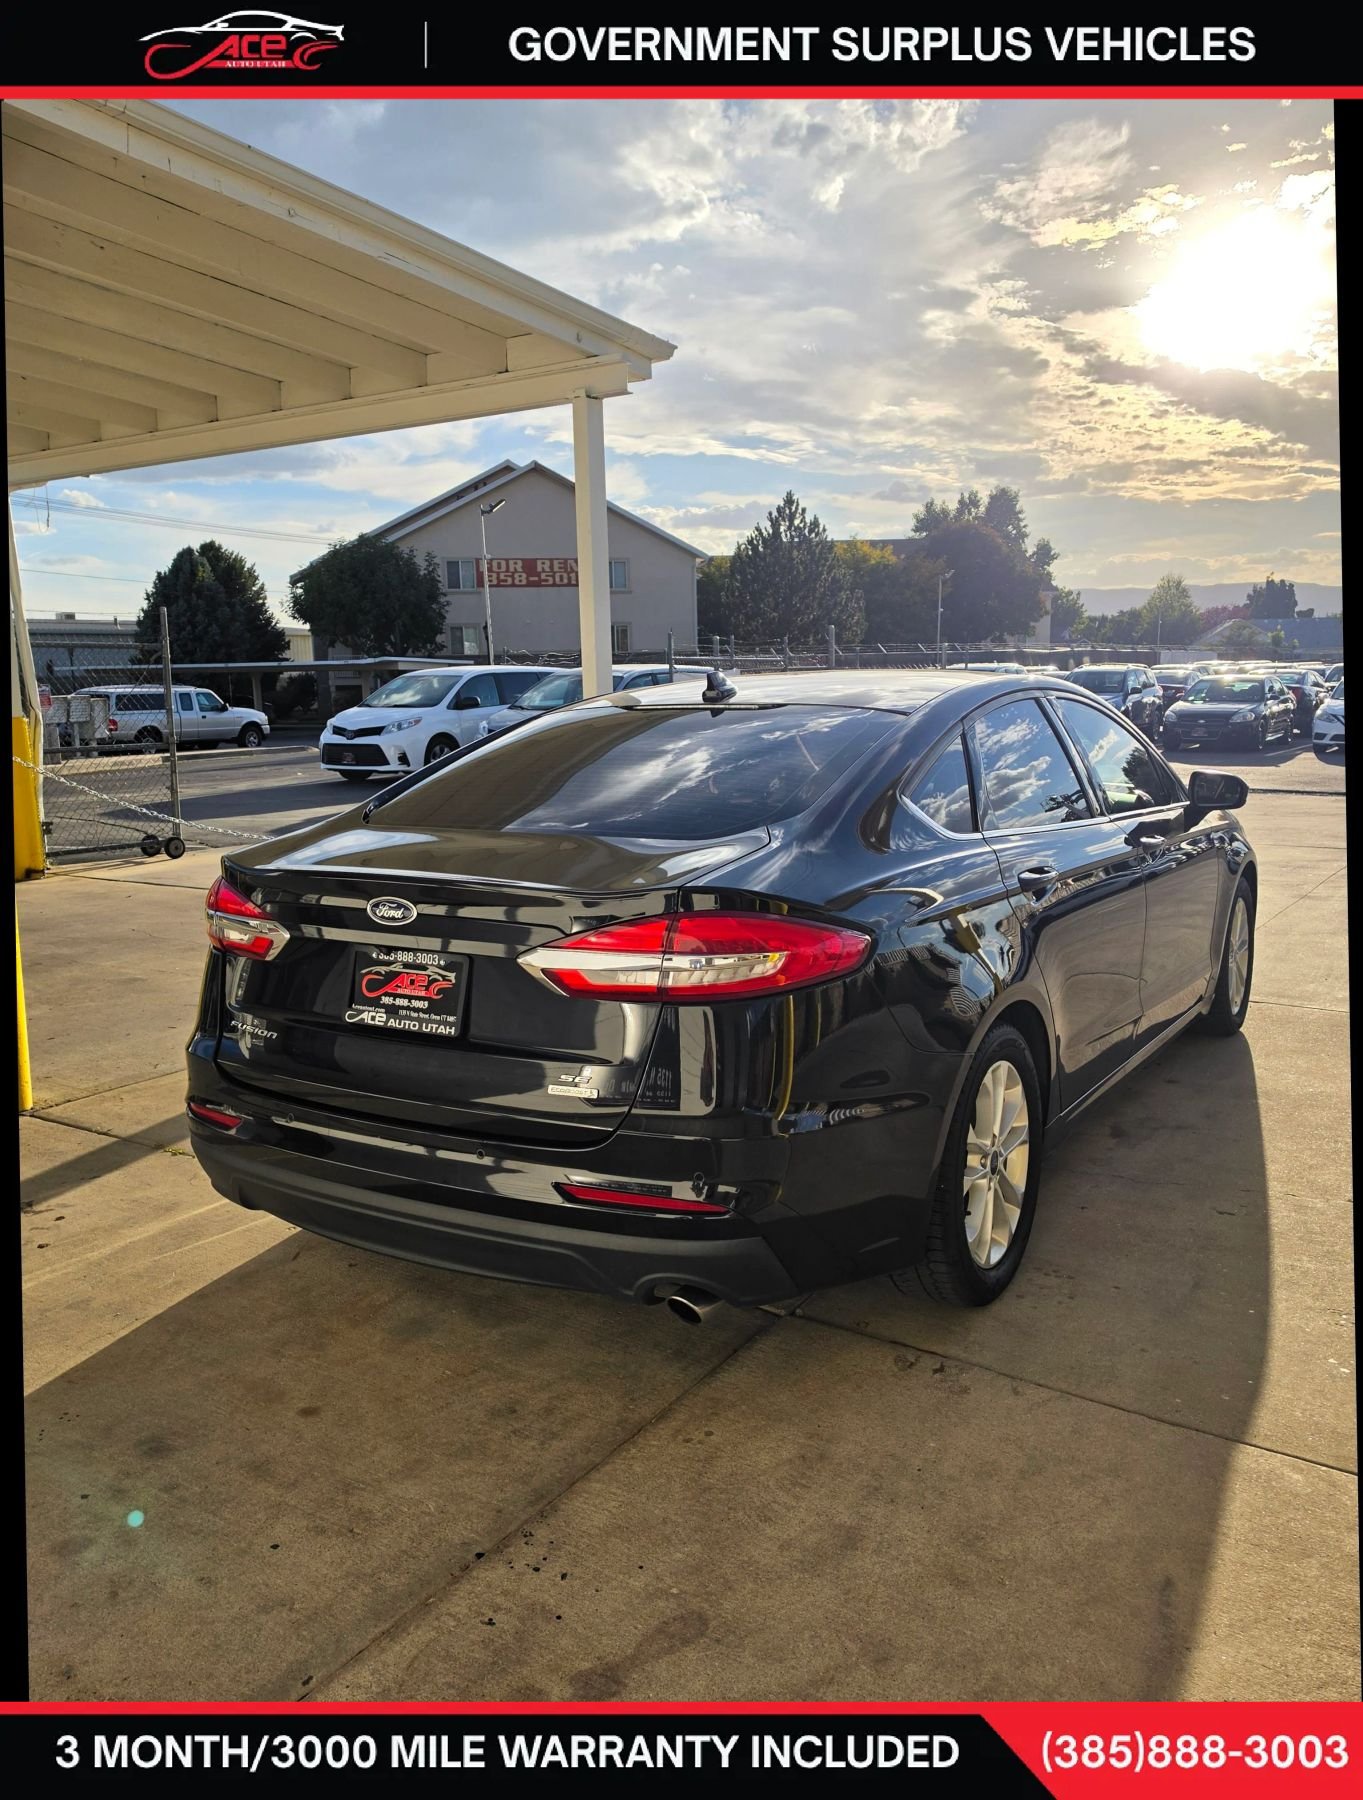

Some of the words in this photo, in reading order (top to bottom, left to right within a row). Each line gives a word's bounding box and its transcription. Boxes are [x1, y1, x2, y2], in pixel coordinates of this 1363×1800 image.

[479, 559, 523, 572] FOR
[536, 559, 578, 572] REN
[376, 902, 404, 918] Ford
[380, 996, 428, 1009] 385-888-3003
[388, 1018, 419, 1030] AUTO
[422, 1025, 456, 1036] UTAH
[558, 1074, 592, 1084] SE
